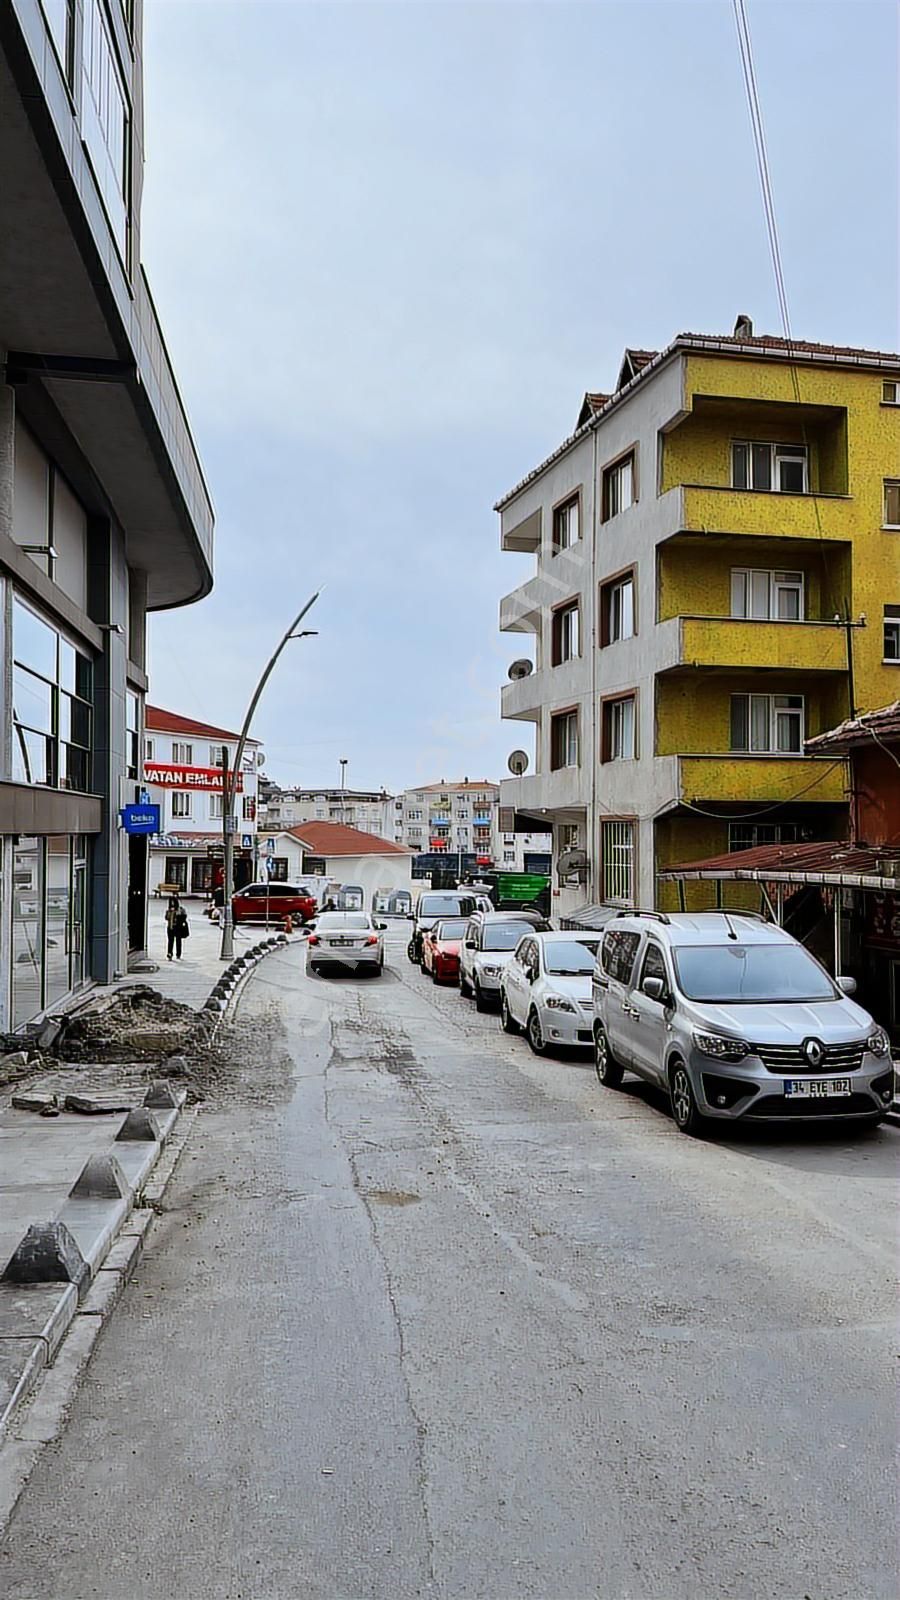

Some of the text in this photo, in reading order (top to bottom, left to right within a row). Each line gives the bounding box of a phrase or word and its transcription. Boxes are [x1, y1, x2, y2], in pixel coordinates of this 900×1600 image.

[143, 769, 183, 783] VATAN
[130, 814, 155, 822] beko
[793, 1081, 805, 1093] 34
